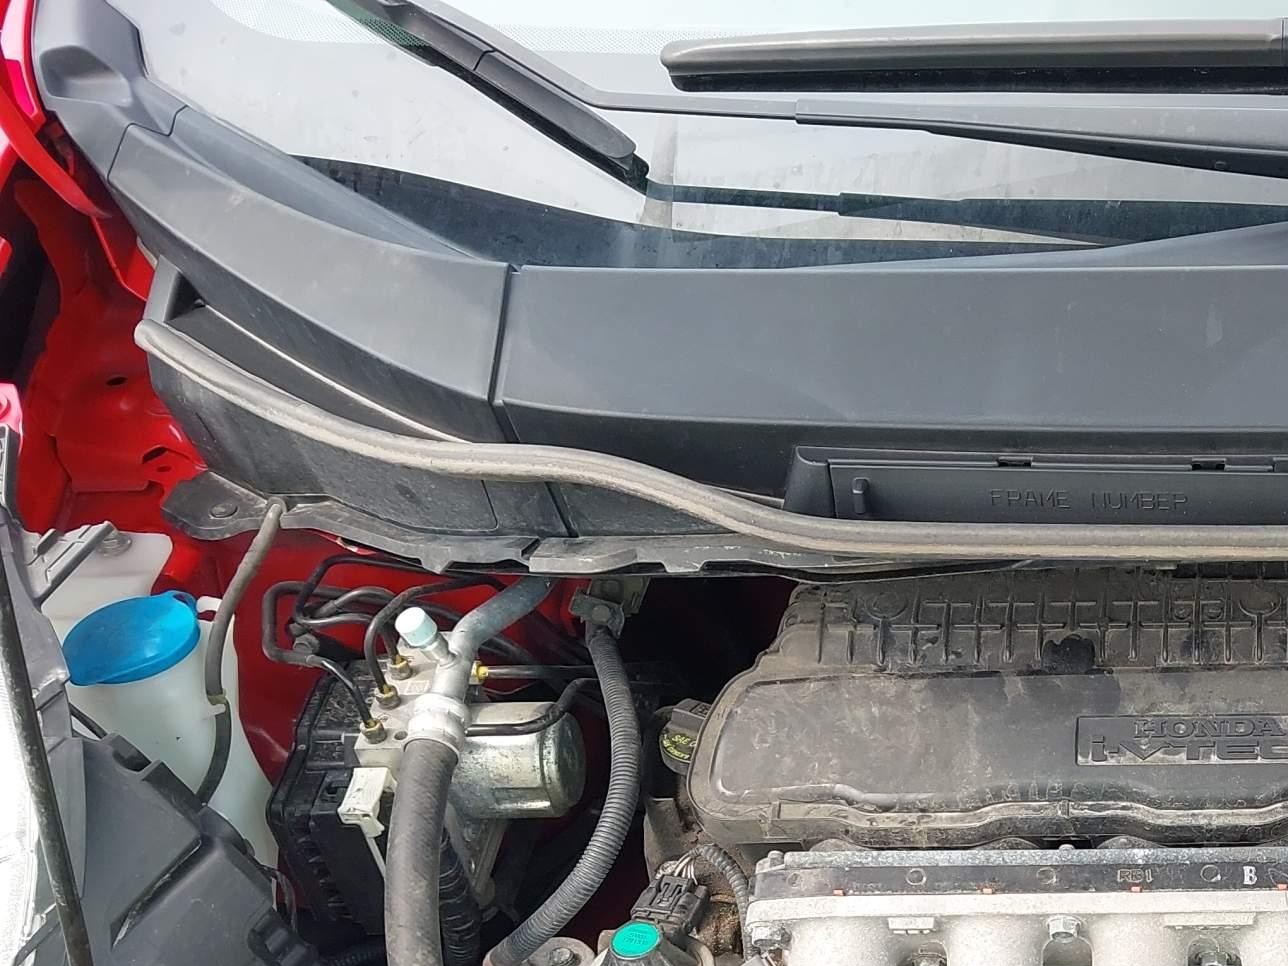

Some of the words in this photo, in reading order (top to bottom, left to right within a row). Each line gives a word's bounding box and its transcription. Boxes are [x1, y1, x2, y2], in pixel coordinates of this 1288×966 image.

[990, 488, 1072, 510] FRAME
[1091, 491, 1188, 512] NUMBER
[1133, 718, 1287, 738] HONDA
[1243, 865, 1257, 885] B
